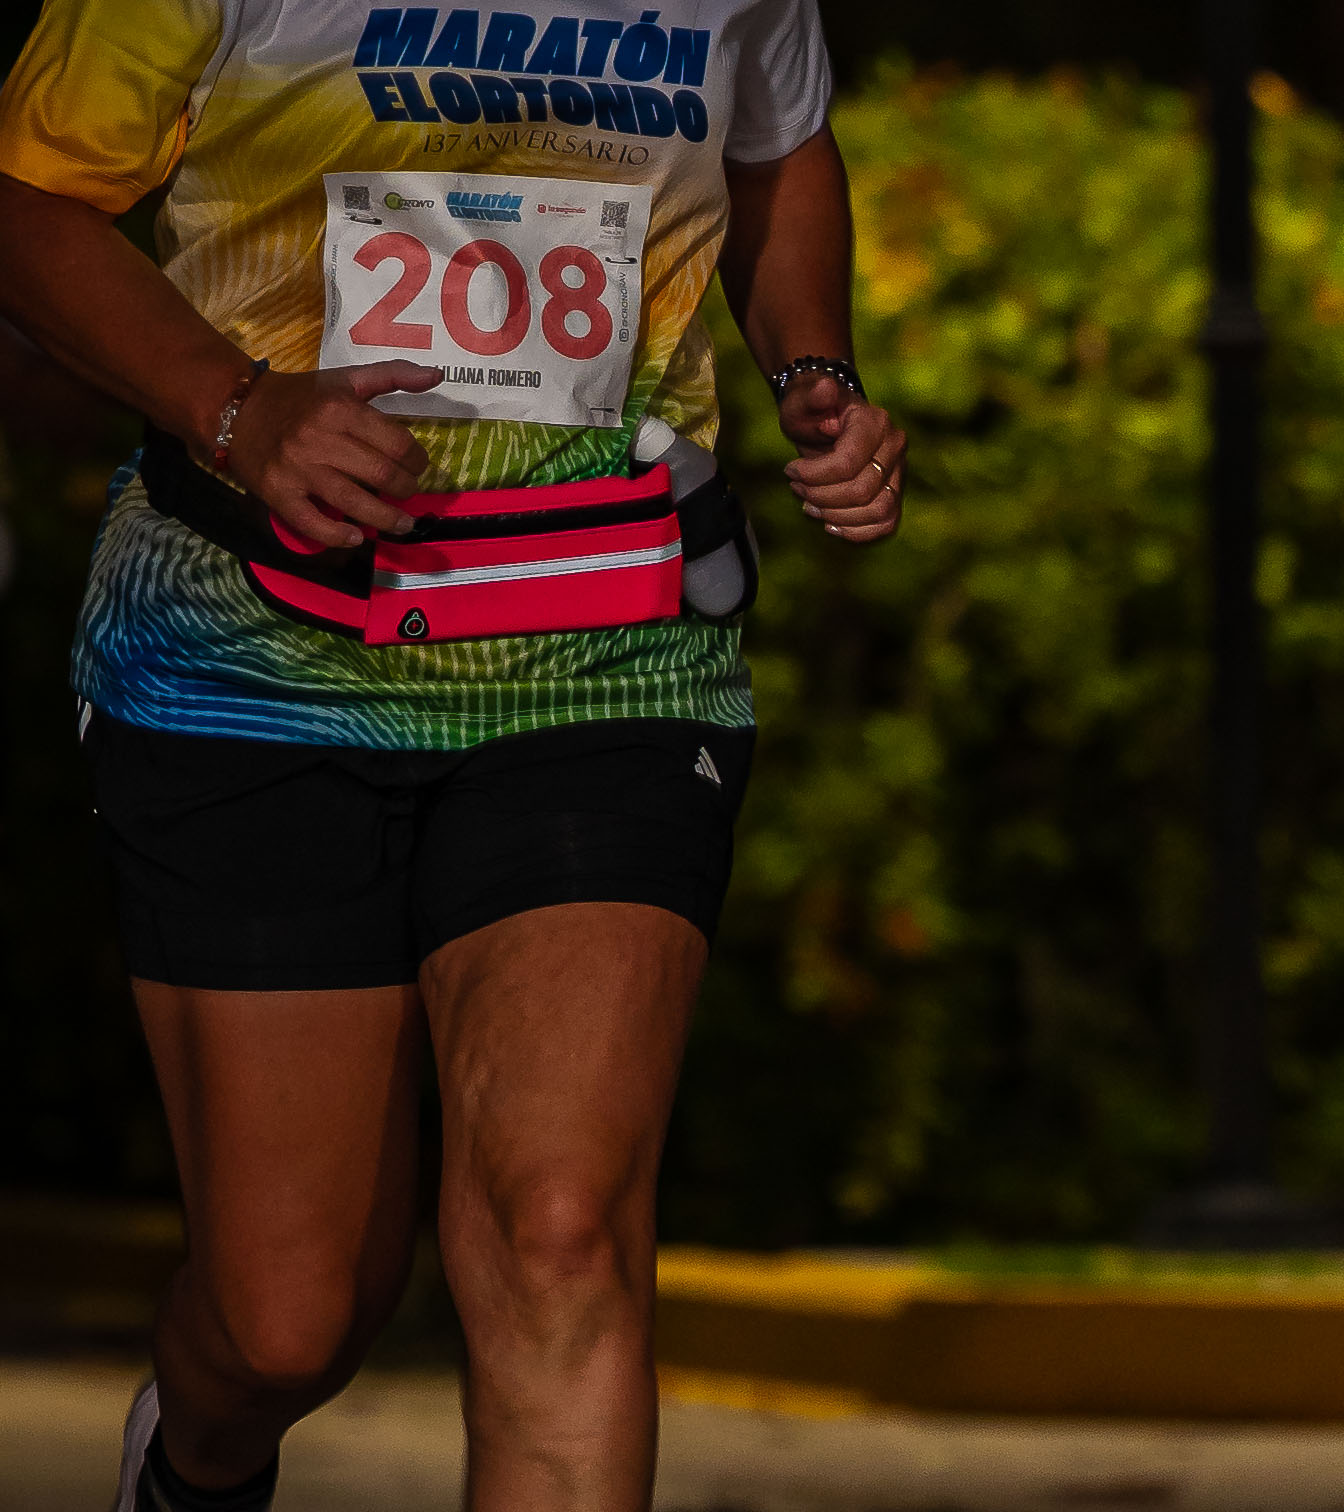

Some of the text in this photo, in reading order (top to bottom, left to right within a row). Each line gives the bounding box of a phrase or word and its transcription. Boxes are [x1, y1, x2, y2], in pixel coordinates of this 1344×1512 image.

[352, 8, 711, 88] MARATÓN
[356, 71, 710, 144] ELORTONDO
[422, 129, 650, 166] 137 ANIVERSARIO
[348, 231, 614, 361] 208
[487, 368, 542, 389] ROMERO
